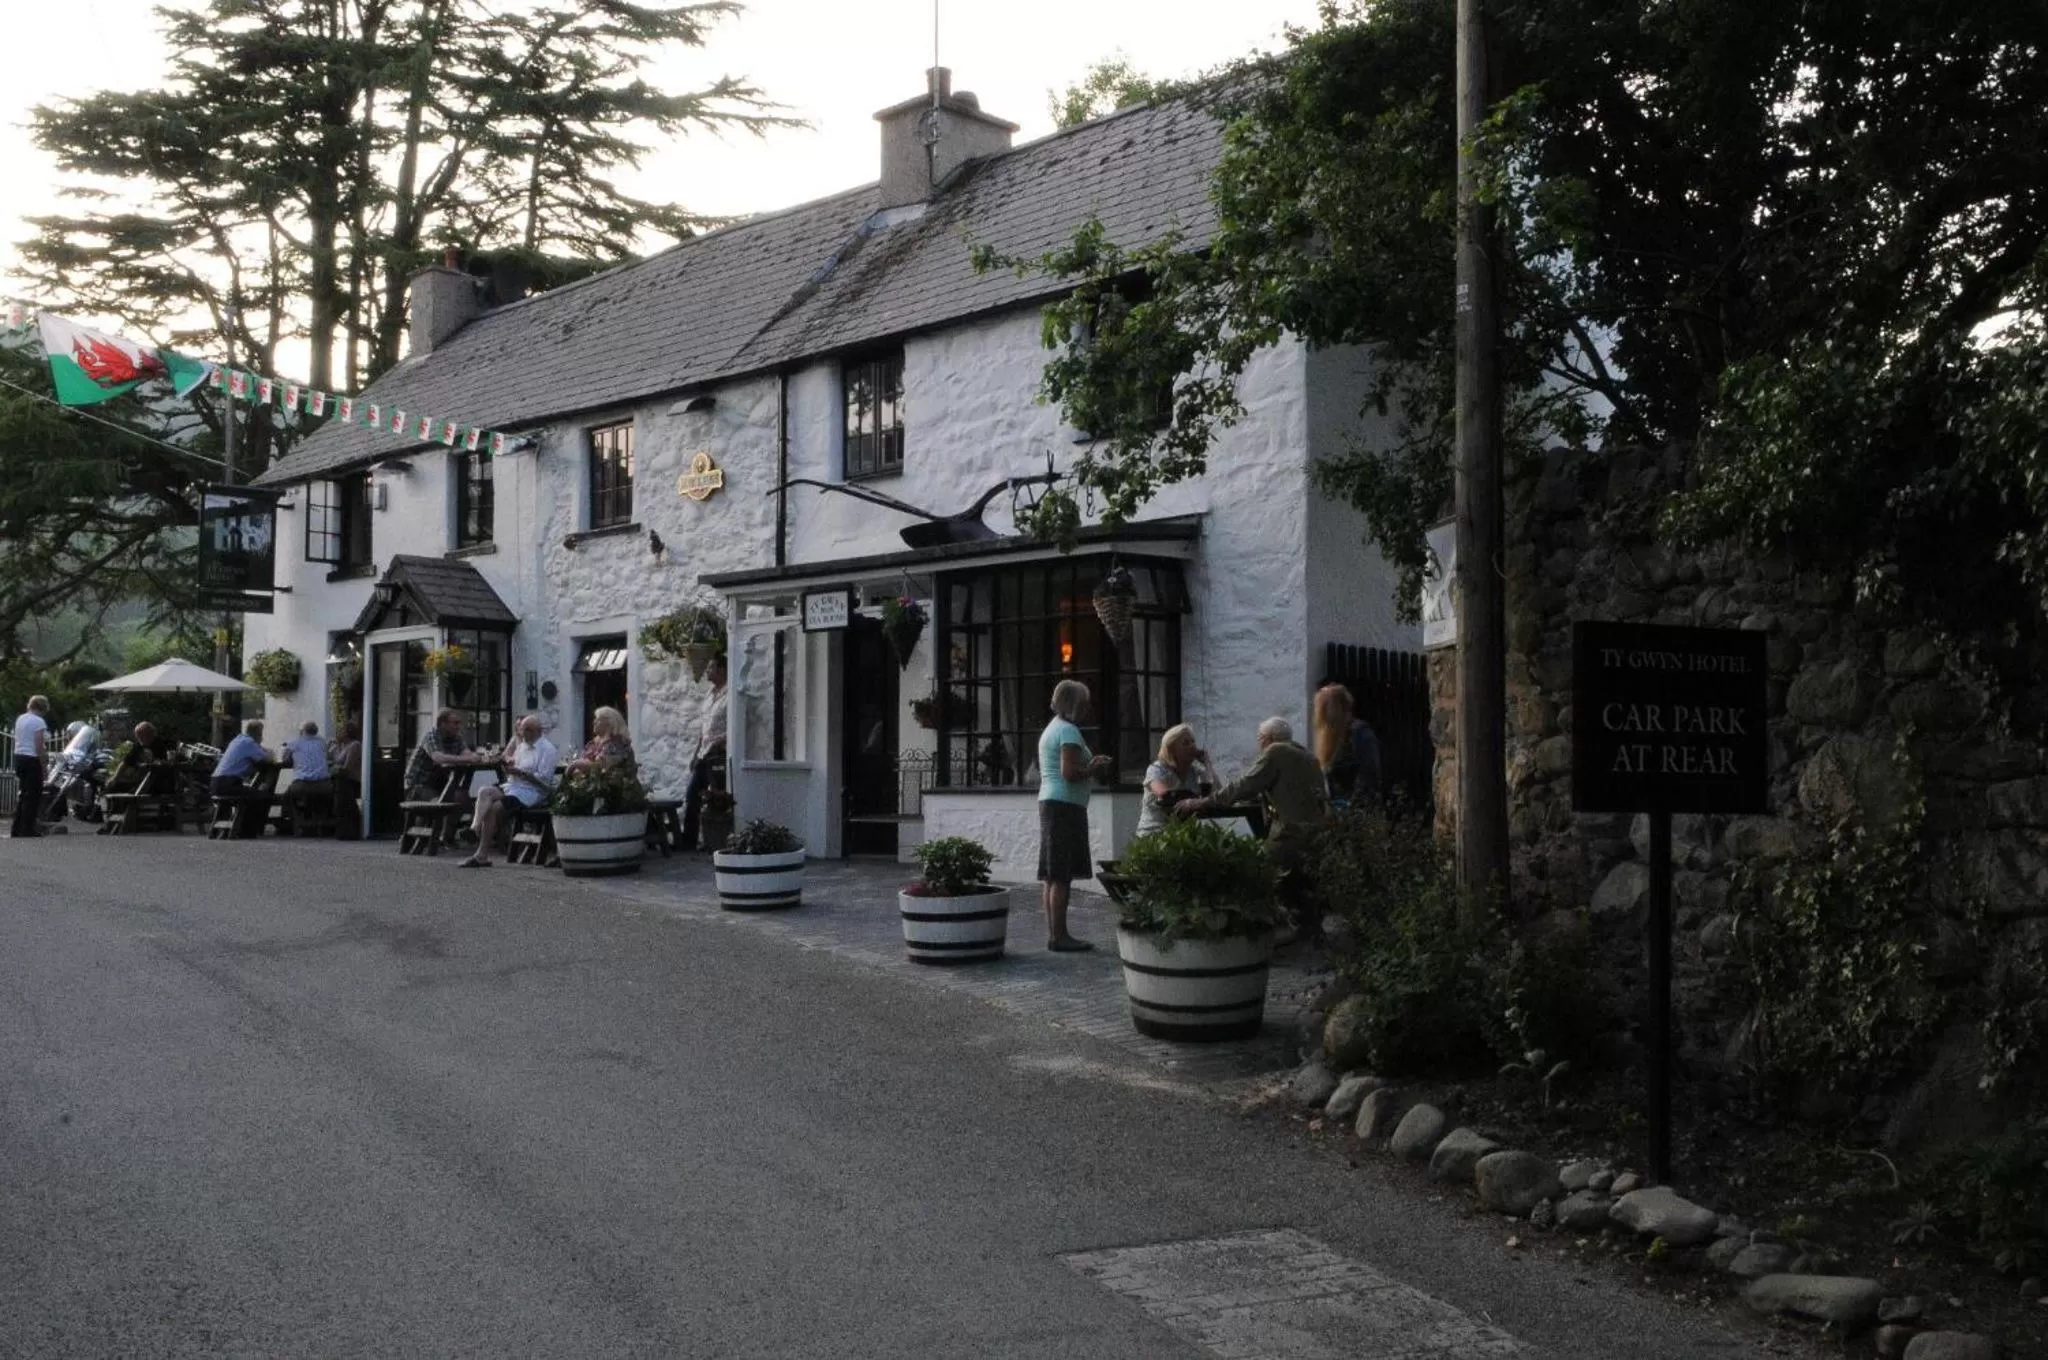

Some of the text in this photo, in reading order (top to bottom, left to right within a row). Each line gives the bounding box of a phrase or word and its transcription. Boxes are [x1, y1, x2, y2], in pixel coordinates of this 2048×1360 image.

[1600, 648, 1752, 674] TY GWYN HOTEL
[1602, 702, 1748, 736] CAR PARK
[1611, 743, 1738, 776] AT REAR
